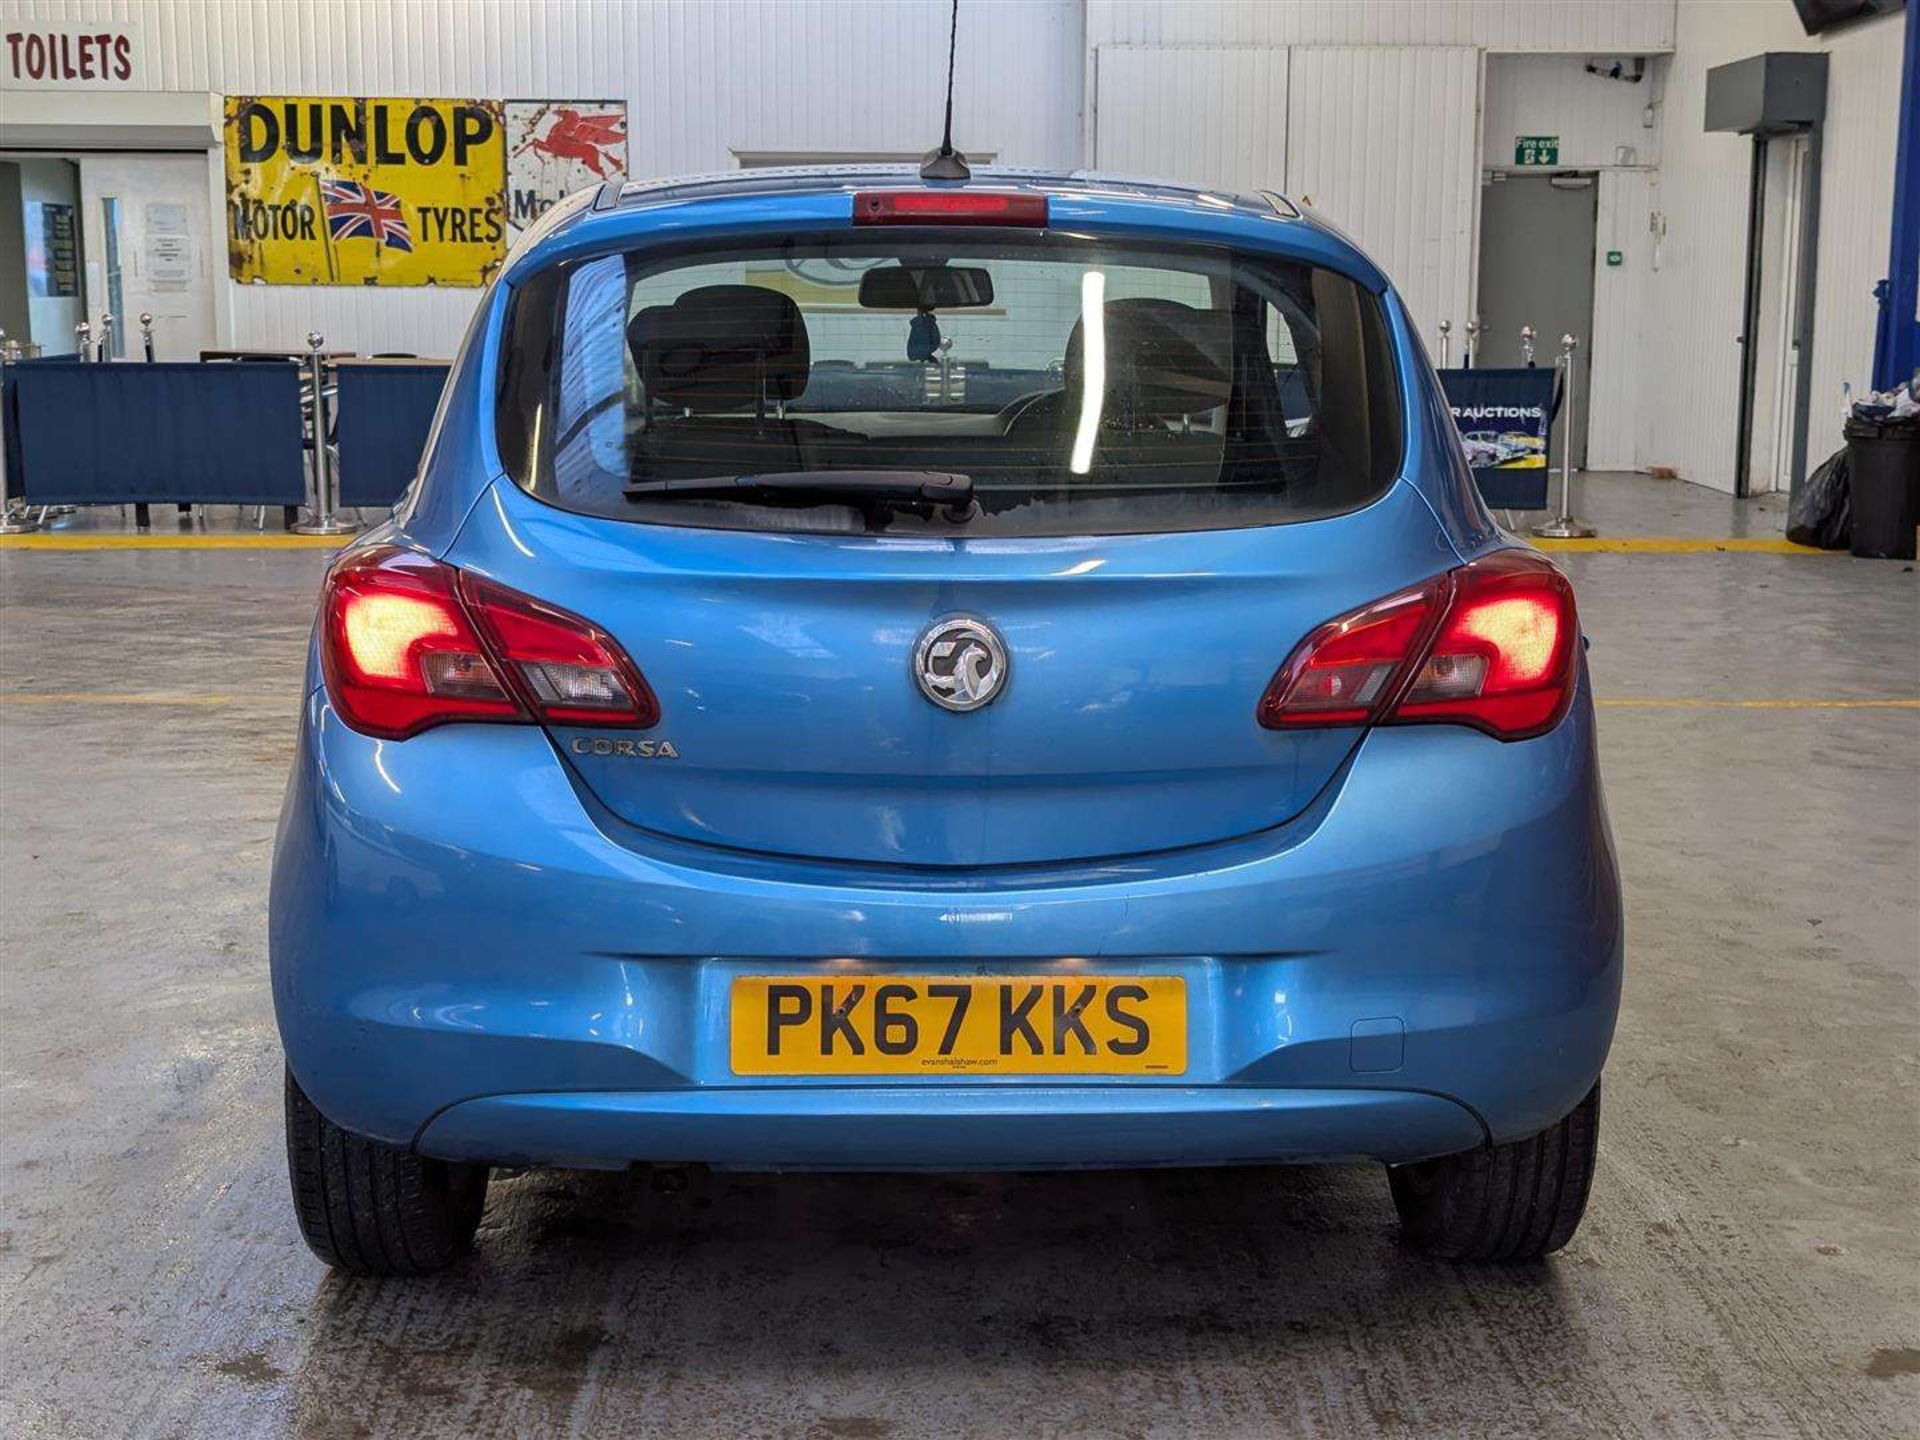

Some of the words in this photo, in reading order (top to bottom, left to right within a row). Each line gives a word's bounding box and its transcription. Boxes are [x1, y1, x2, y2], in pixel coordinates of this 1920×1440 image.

[6, 33, 131, 80] TOILETS
[239, 103, 494, 167] DUNLOP
[1515, 139, 1537, 149] Fire
[1538, 140, 1559, 149] exit
[233, 203, 316, 241] MOTOR
[417, 207, 501, 243] TYRES
[1463, 407, 1541, 418] AUCTIONS
[571, 738, 680, 758] CORSA
[767, 985, 972, 1056] PK67
[1000, 985, 1150, 1056] KKS
[921, 1057, 998, 1066] evanshalshaw.com
